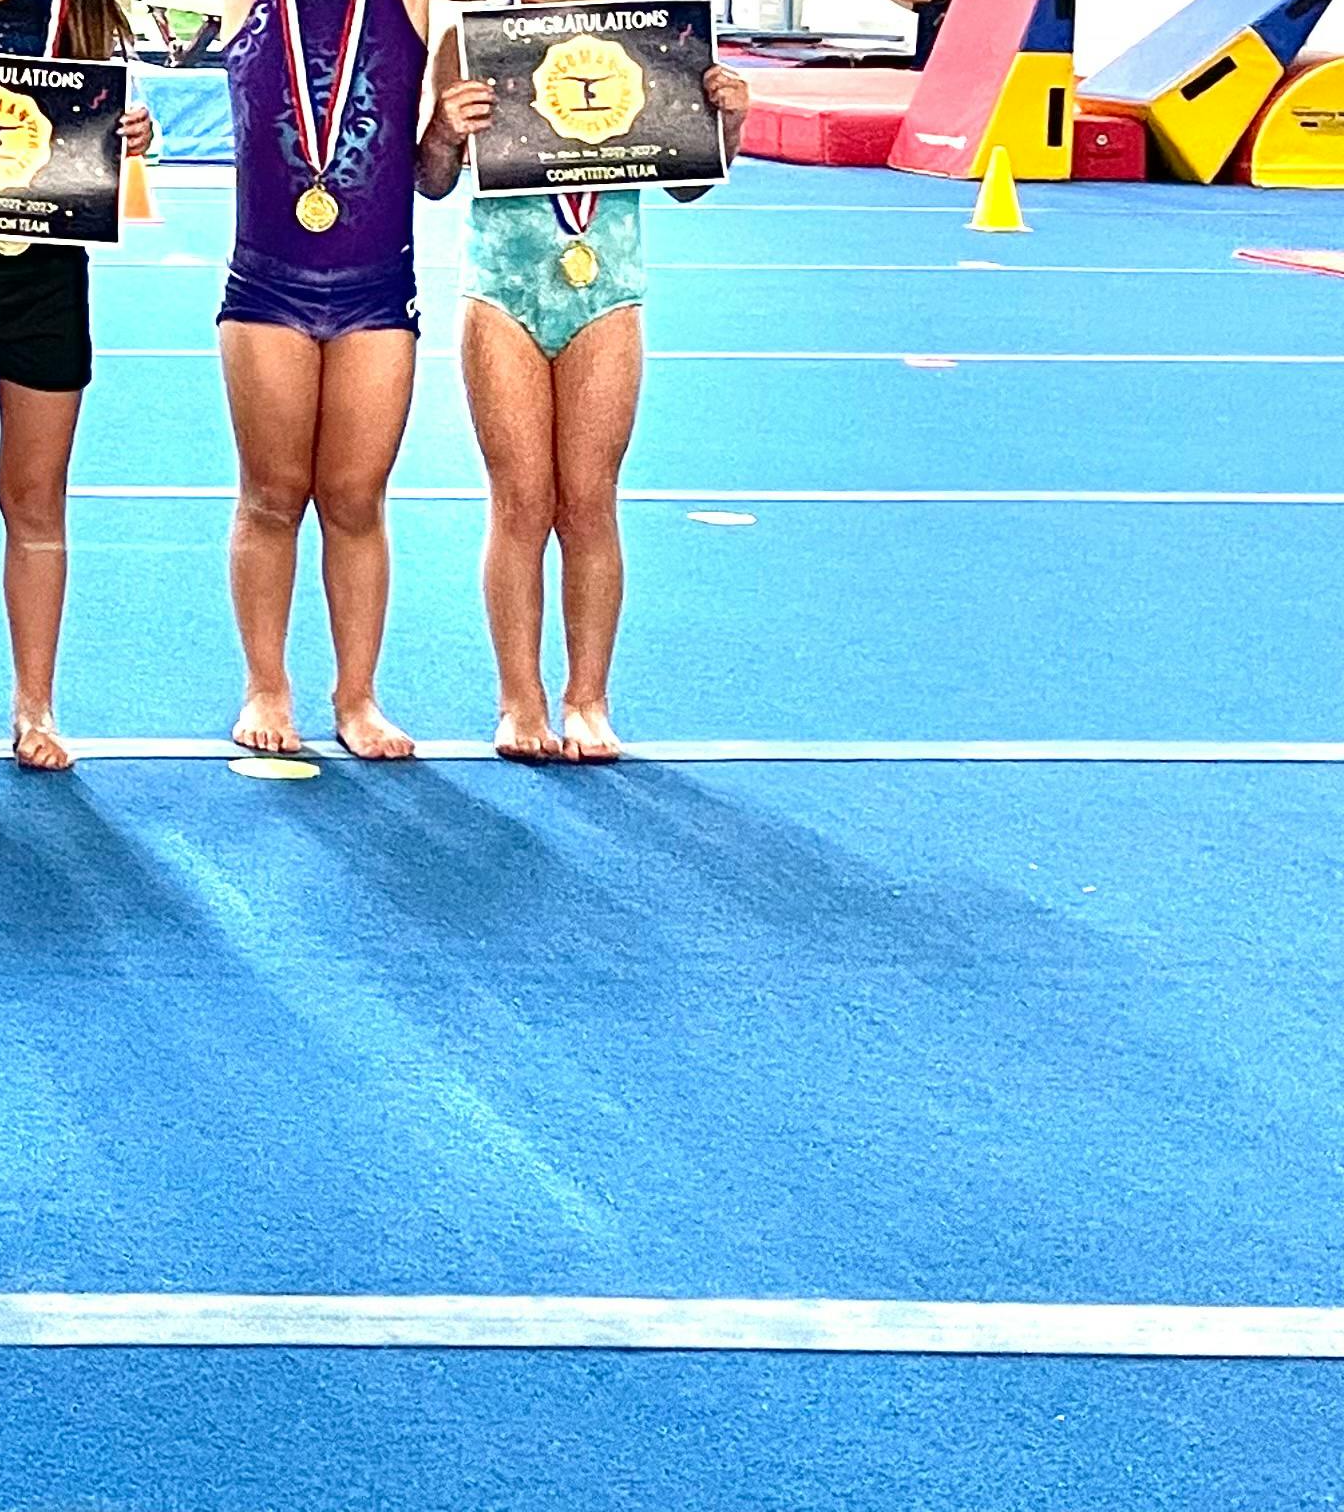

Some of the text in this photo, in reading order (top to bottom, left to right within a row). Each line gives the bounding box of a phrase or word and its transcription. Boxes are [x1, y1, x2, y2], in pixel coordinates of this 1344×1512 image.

[502, 10, 669, 39] CONGRATULATIONS
[545, 164, 659, 182] COMPETITION TEAM
[18, 218, 50, 234] TEAM
